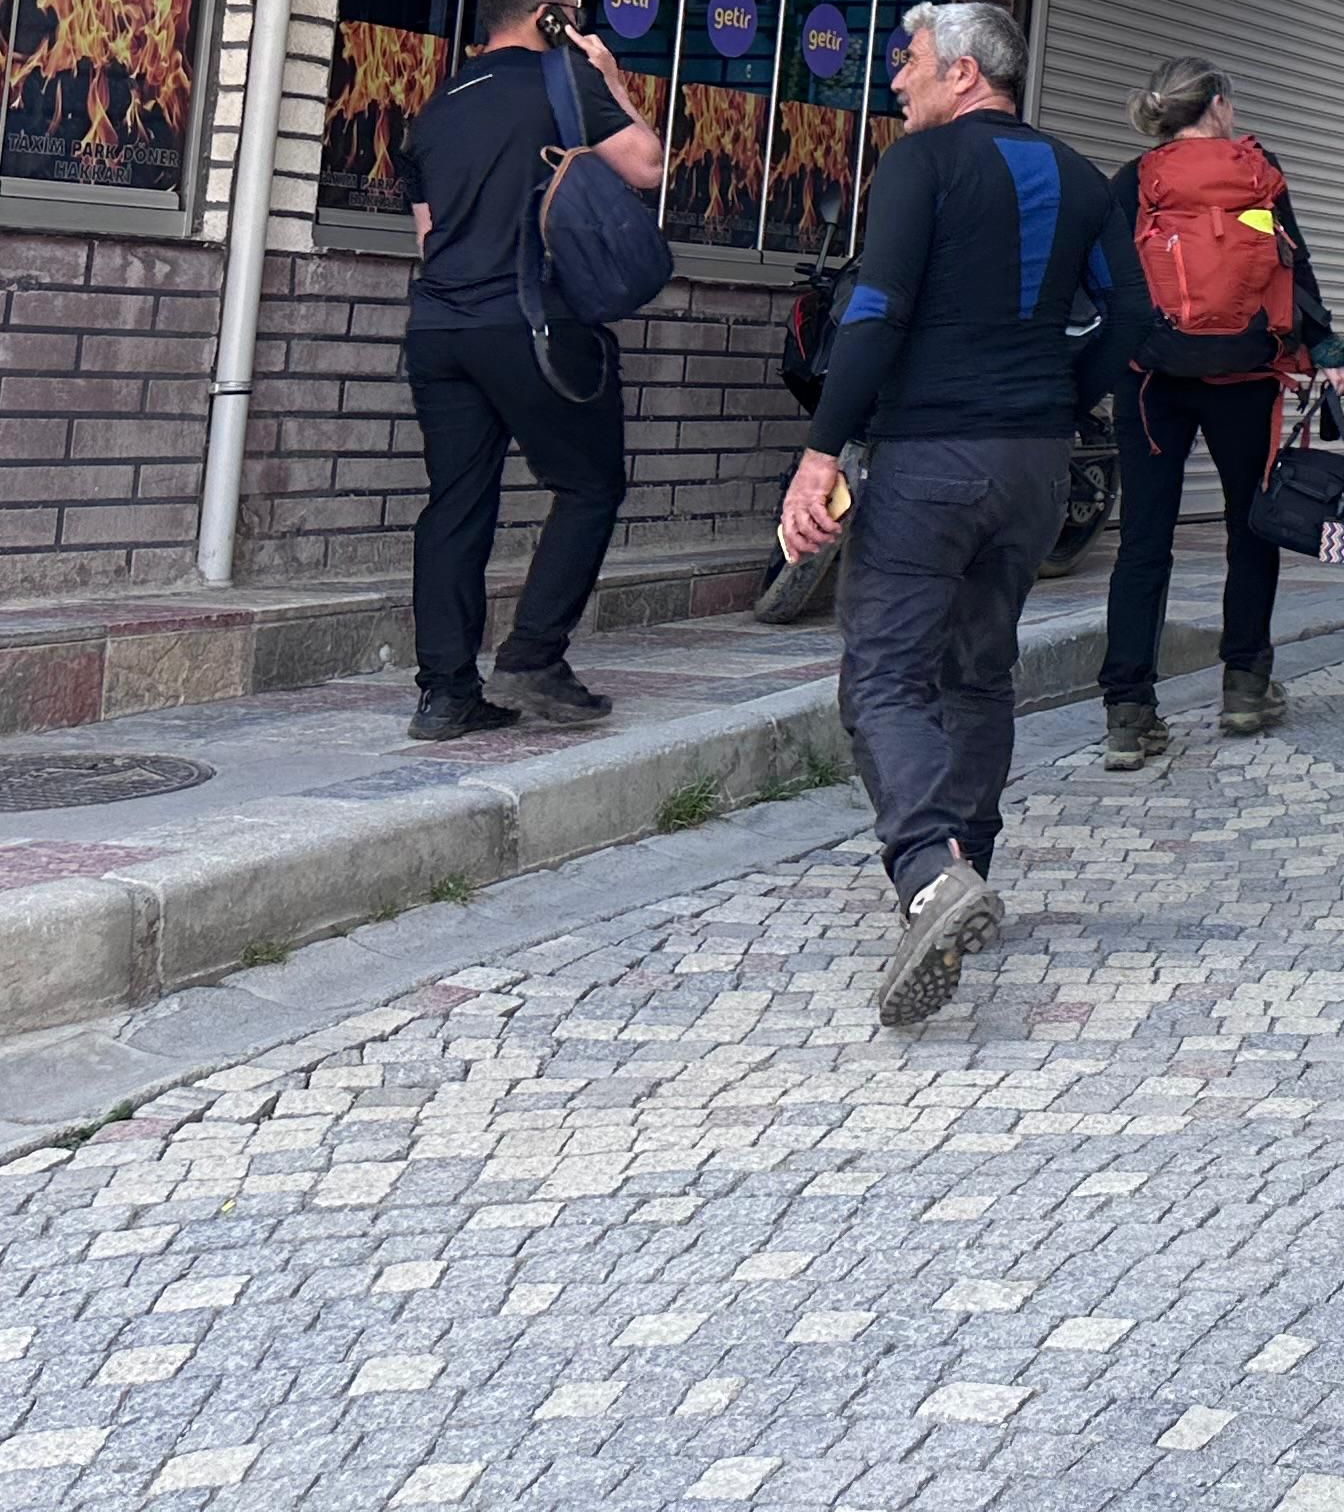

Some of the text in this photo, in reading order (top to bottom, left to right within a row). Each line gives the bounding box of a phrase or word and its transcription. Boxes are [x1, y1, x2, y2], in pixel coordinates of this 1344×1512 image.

[713, 6, 752, 30] getir
[808, 29, 843, 52] getir
[71, 139, 118, 162] PARK
[122, 140, 180, 168] DÖNER
[54, 159, 133, 185] HAKKARİ
